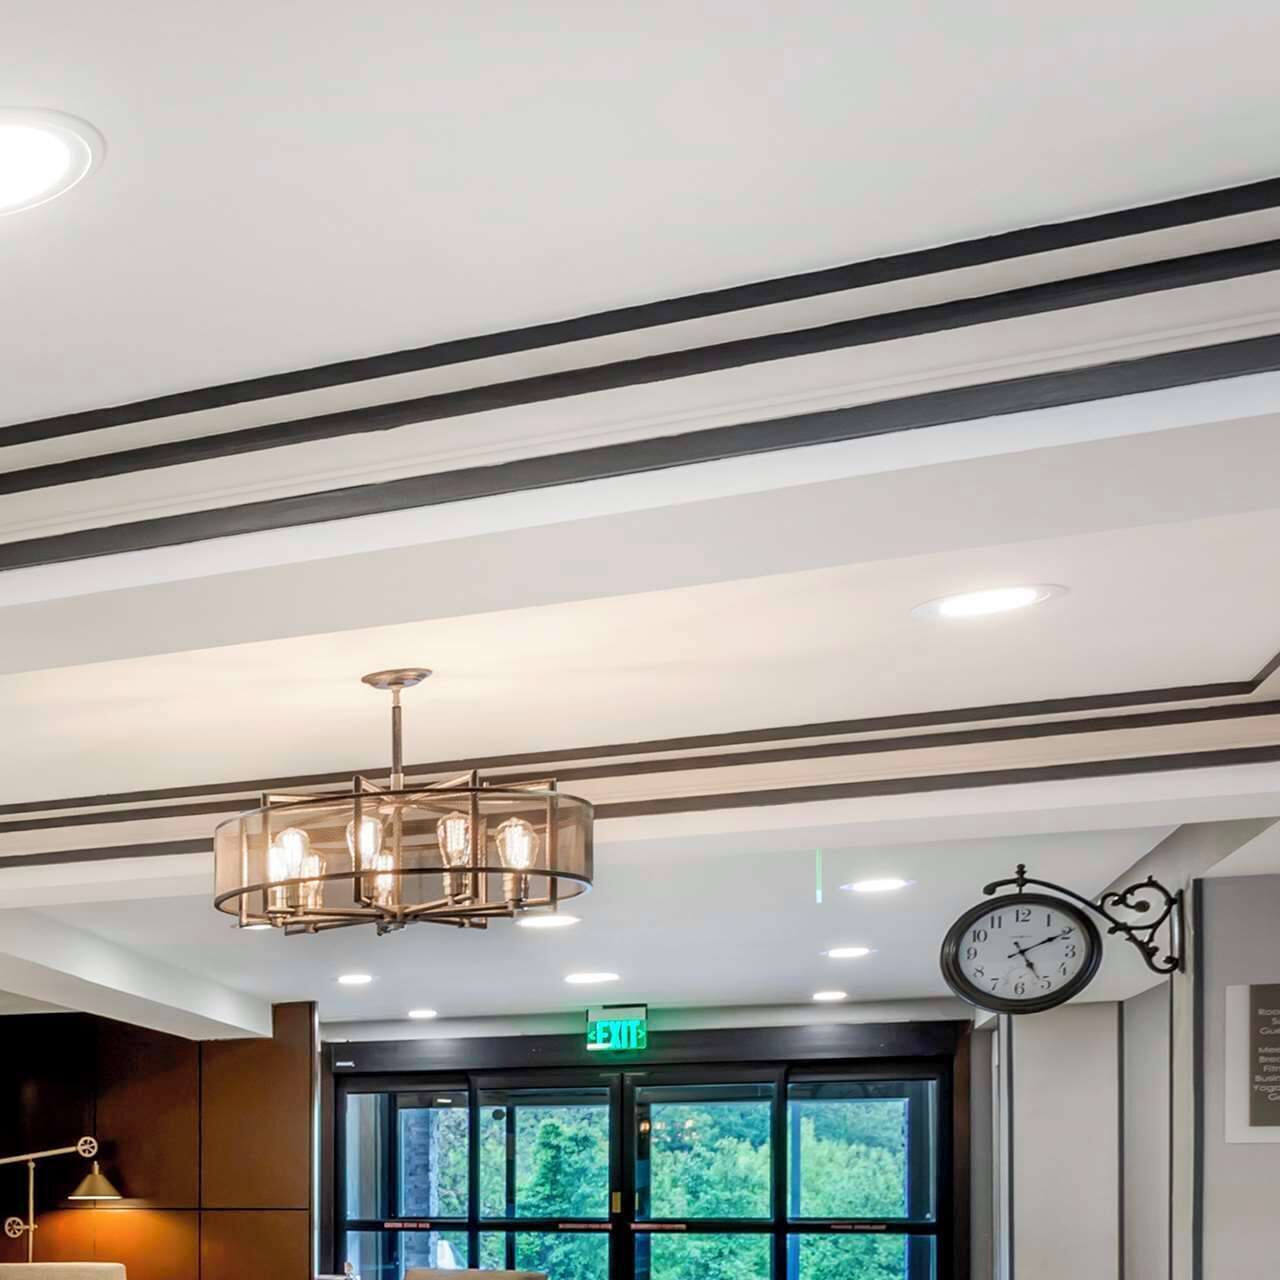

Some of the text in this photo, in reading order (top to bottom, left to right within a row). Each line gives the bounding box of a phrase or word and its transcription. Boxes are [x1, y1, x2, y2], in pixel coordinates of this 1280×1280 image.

[990, 915, 1002, 929] 11
[1015, 909, 1032, 923] 12
[972, 929, 987, 943] 10
[966, 947, 978, 960] 9
[1064, 944, 1076, 959] 3
[973, 965, 985, 978] 8
[1058, 961, 1067, 976] 4
[990, 977, 1000, 991] 7
[1014, 981, 1025, 995] 6
[1040, 975, 1052, 990] 5
[596, 1020, 641, 1049] EXIT
